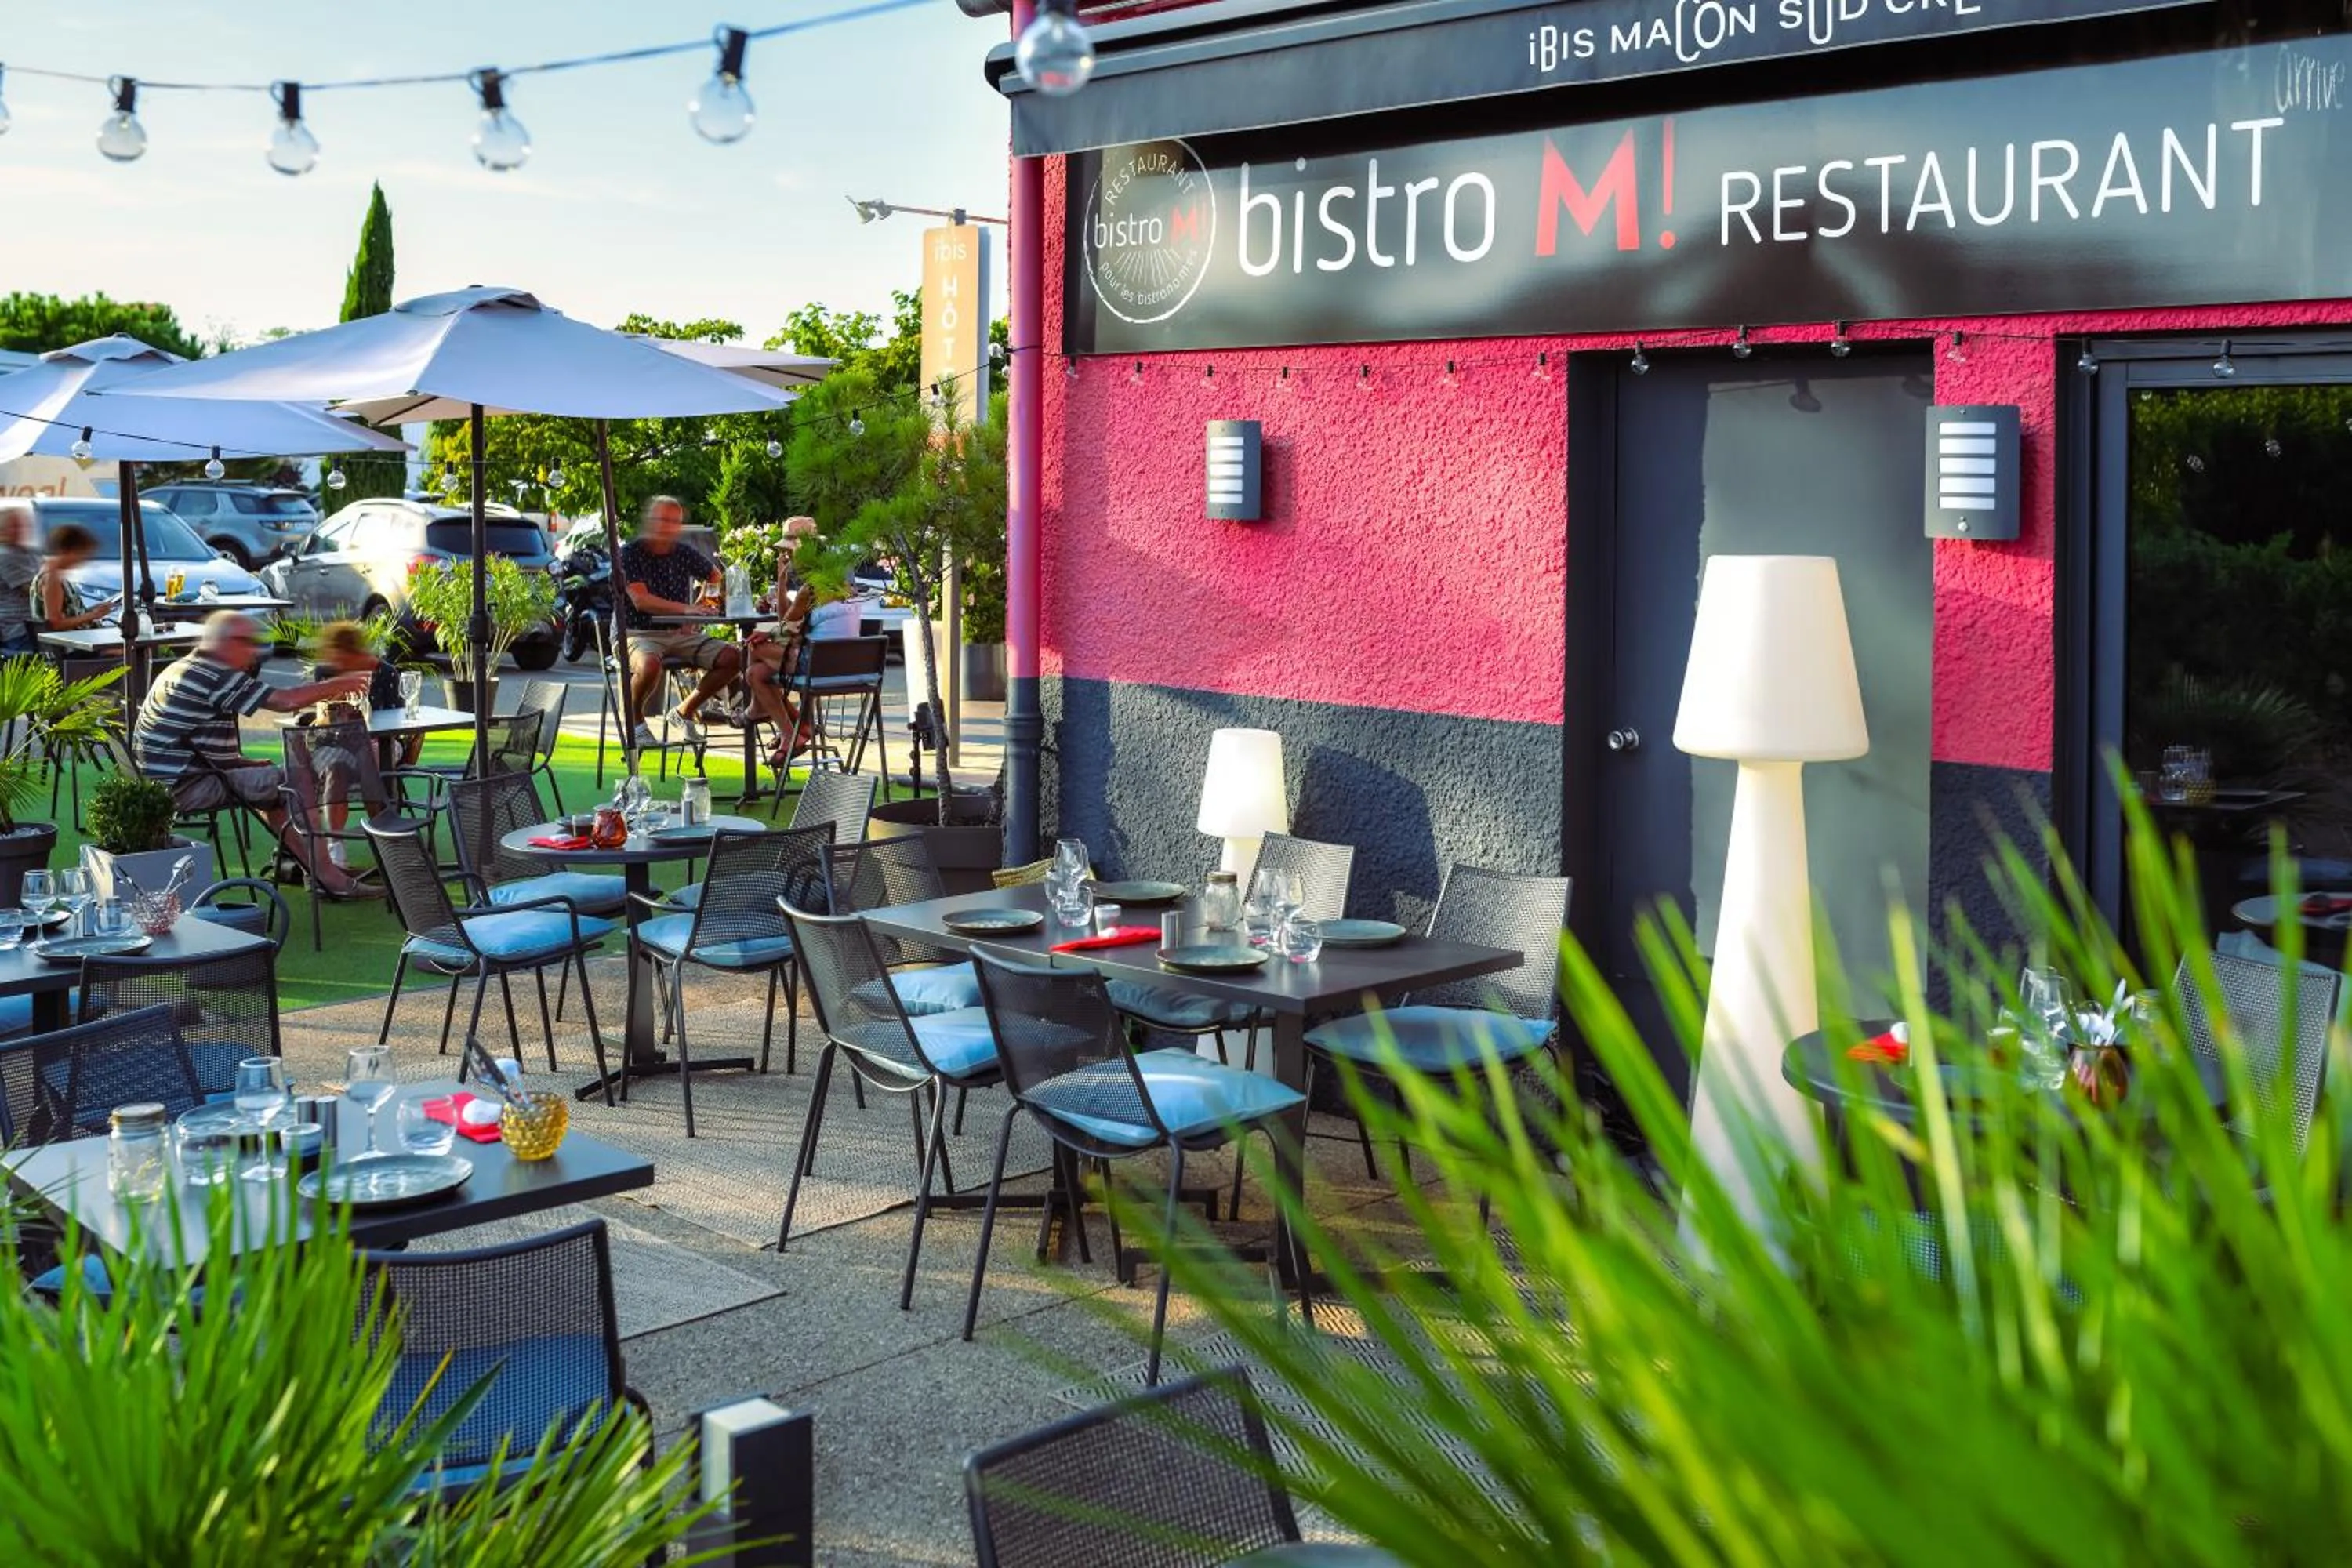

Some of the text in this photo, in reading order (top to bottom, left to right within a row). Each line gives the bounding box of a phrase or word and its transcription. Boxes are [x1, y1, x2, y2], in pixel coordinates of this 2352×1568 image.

[1610, 0, 1755, 62] MACON
[1778, 0, 1868, 45] SUD
[1105, 153, 1196, 205] RESTAURANT
[1236, 117, 2285, 278] bistro M! RESTAURANT
[933, 237, 967, 262] ibis
[1094, 212, 1163, 249] bistro
[1099, 262, 1122, 291] pour
